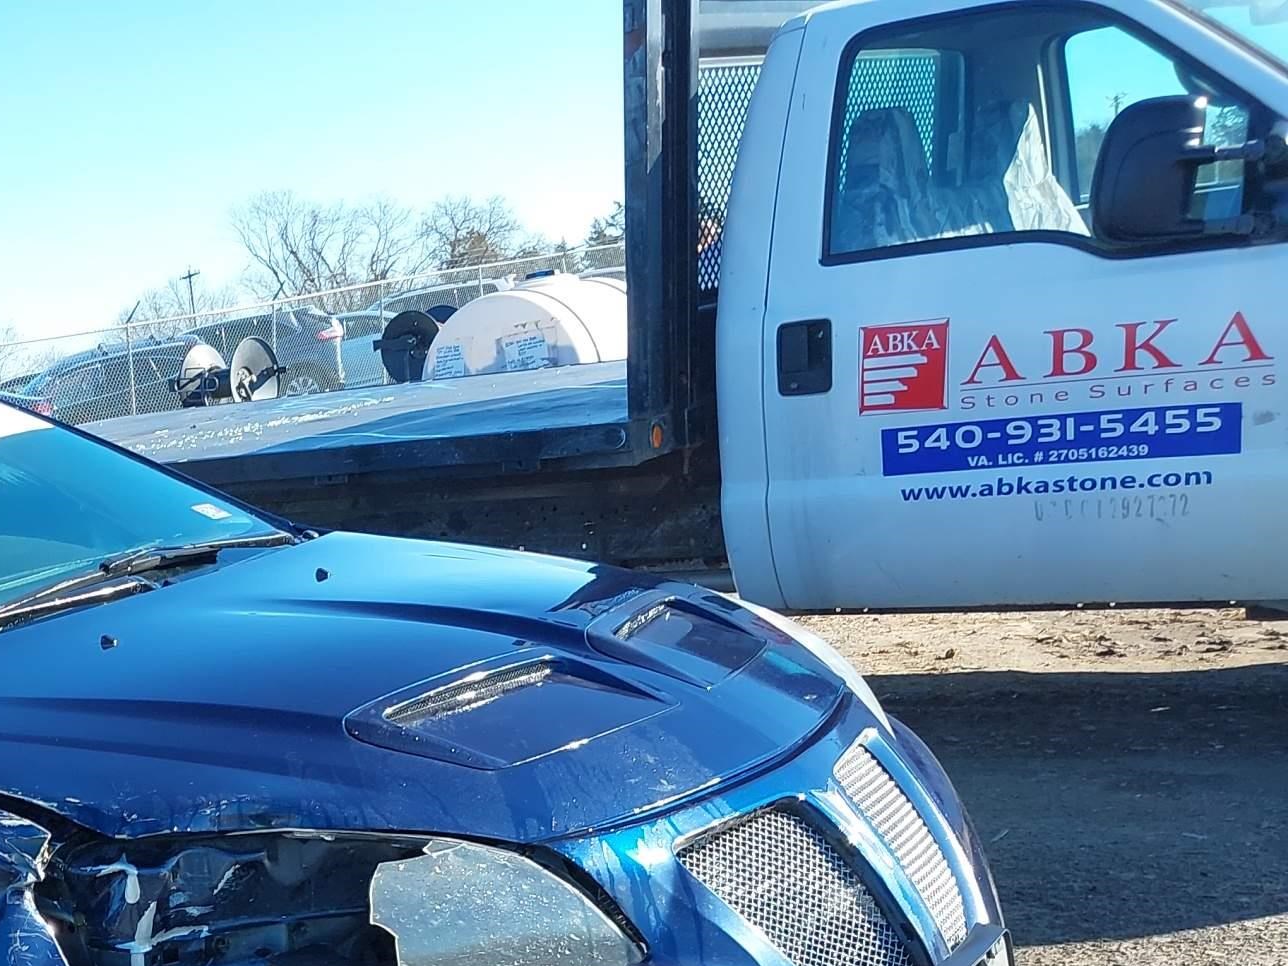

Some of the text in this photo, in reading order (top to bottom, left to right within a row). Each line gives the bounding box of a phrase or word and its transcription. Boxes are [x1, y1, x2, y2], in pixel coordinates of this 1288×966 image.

[866, 328, 941, 356] ABKA
[960, 310, 1275, 384] ABKA
[960, 372, 1277, 410] Stone Surfaces
[896, 406, 1223, 453] 540-931-5455
[967, 444, 1149, 466] VA. LIC. # 2705162439
[900, 470, 1213, 501] www.abkastone.com
